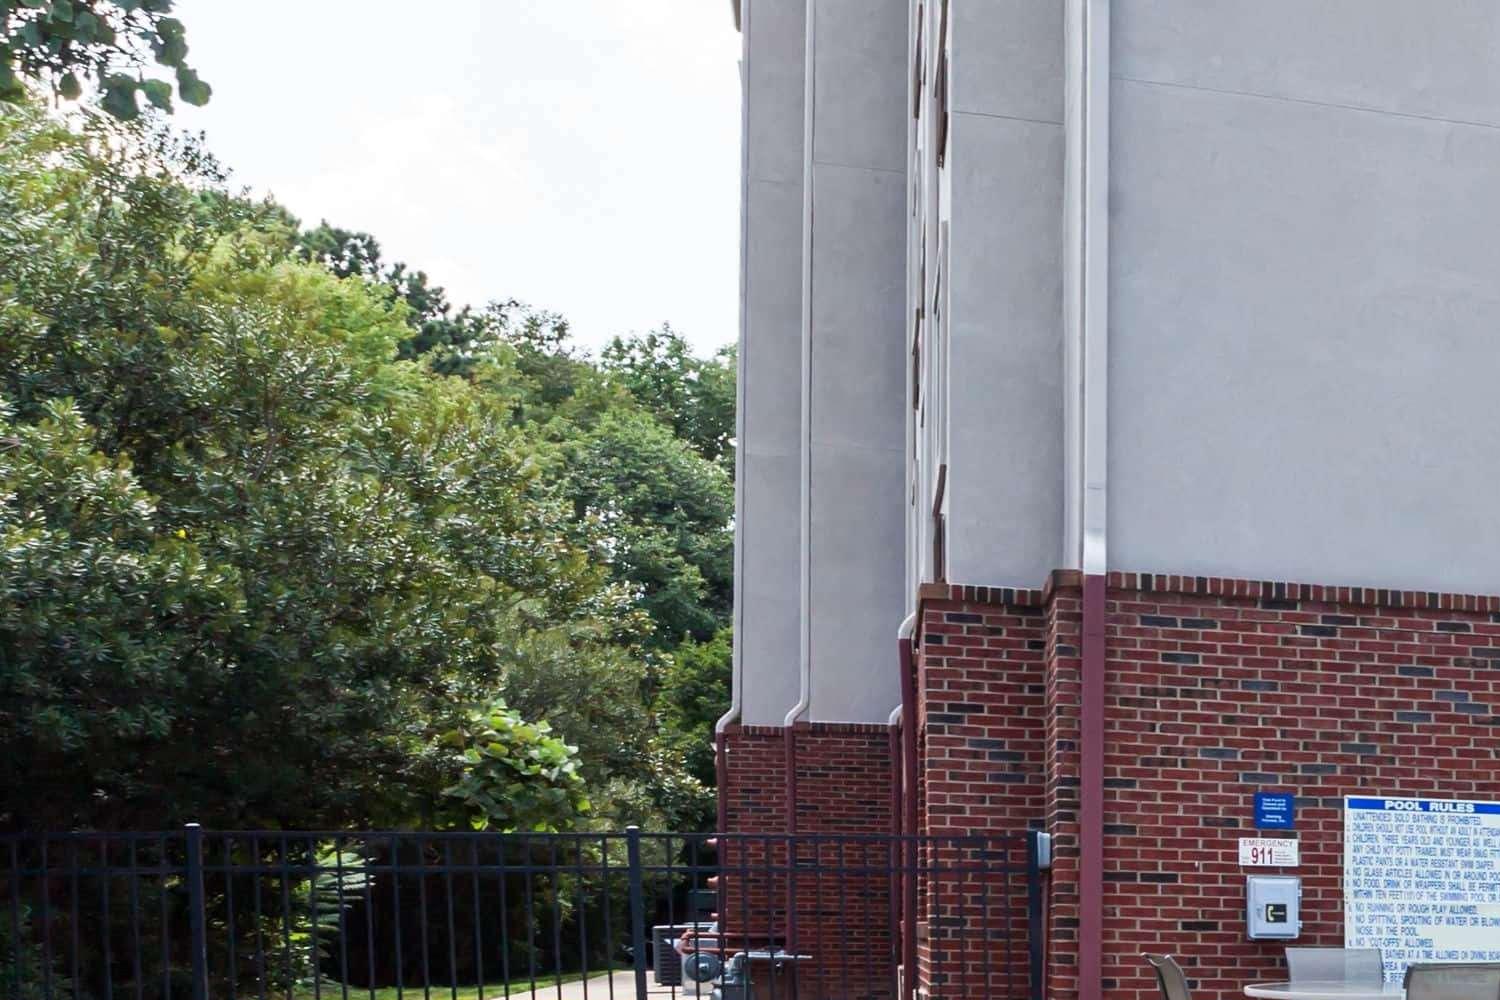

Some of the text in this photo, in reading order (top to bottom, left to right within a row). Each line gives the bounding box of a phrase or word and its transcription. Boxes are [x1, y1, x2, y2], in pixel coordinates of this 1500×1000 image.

[1385, 800, 1475, 813] POOL RULES
[1243, 839, 1294, 848] EMERGENCY
[1251, 847, 1273, 865] 911
[1352, 867, 1362, 877] NO
[1364, 867, 1383, 878] GLASS
[1386, 868, 1412, 878] ARTICLES
[1415, 869, 1442, 880] ALLOWED
[1464, 870, 1488, 880] AROUND
[1352, 878, 1362, 888] NO
[1356, 902, 1364, 913] NO
[1408, 904, 1430, 914] ROUGH
[1432, 904, 1448, 914] PLAY
[1356, 914, 1365, 924] NO
[1400, 915, 1432, 926] SPOUTING
[1446, 916, 1468, 926] WATER
[1356, 937, 1364, 947] NO
